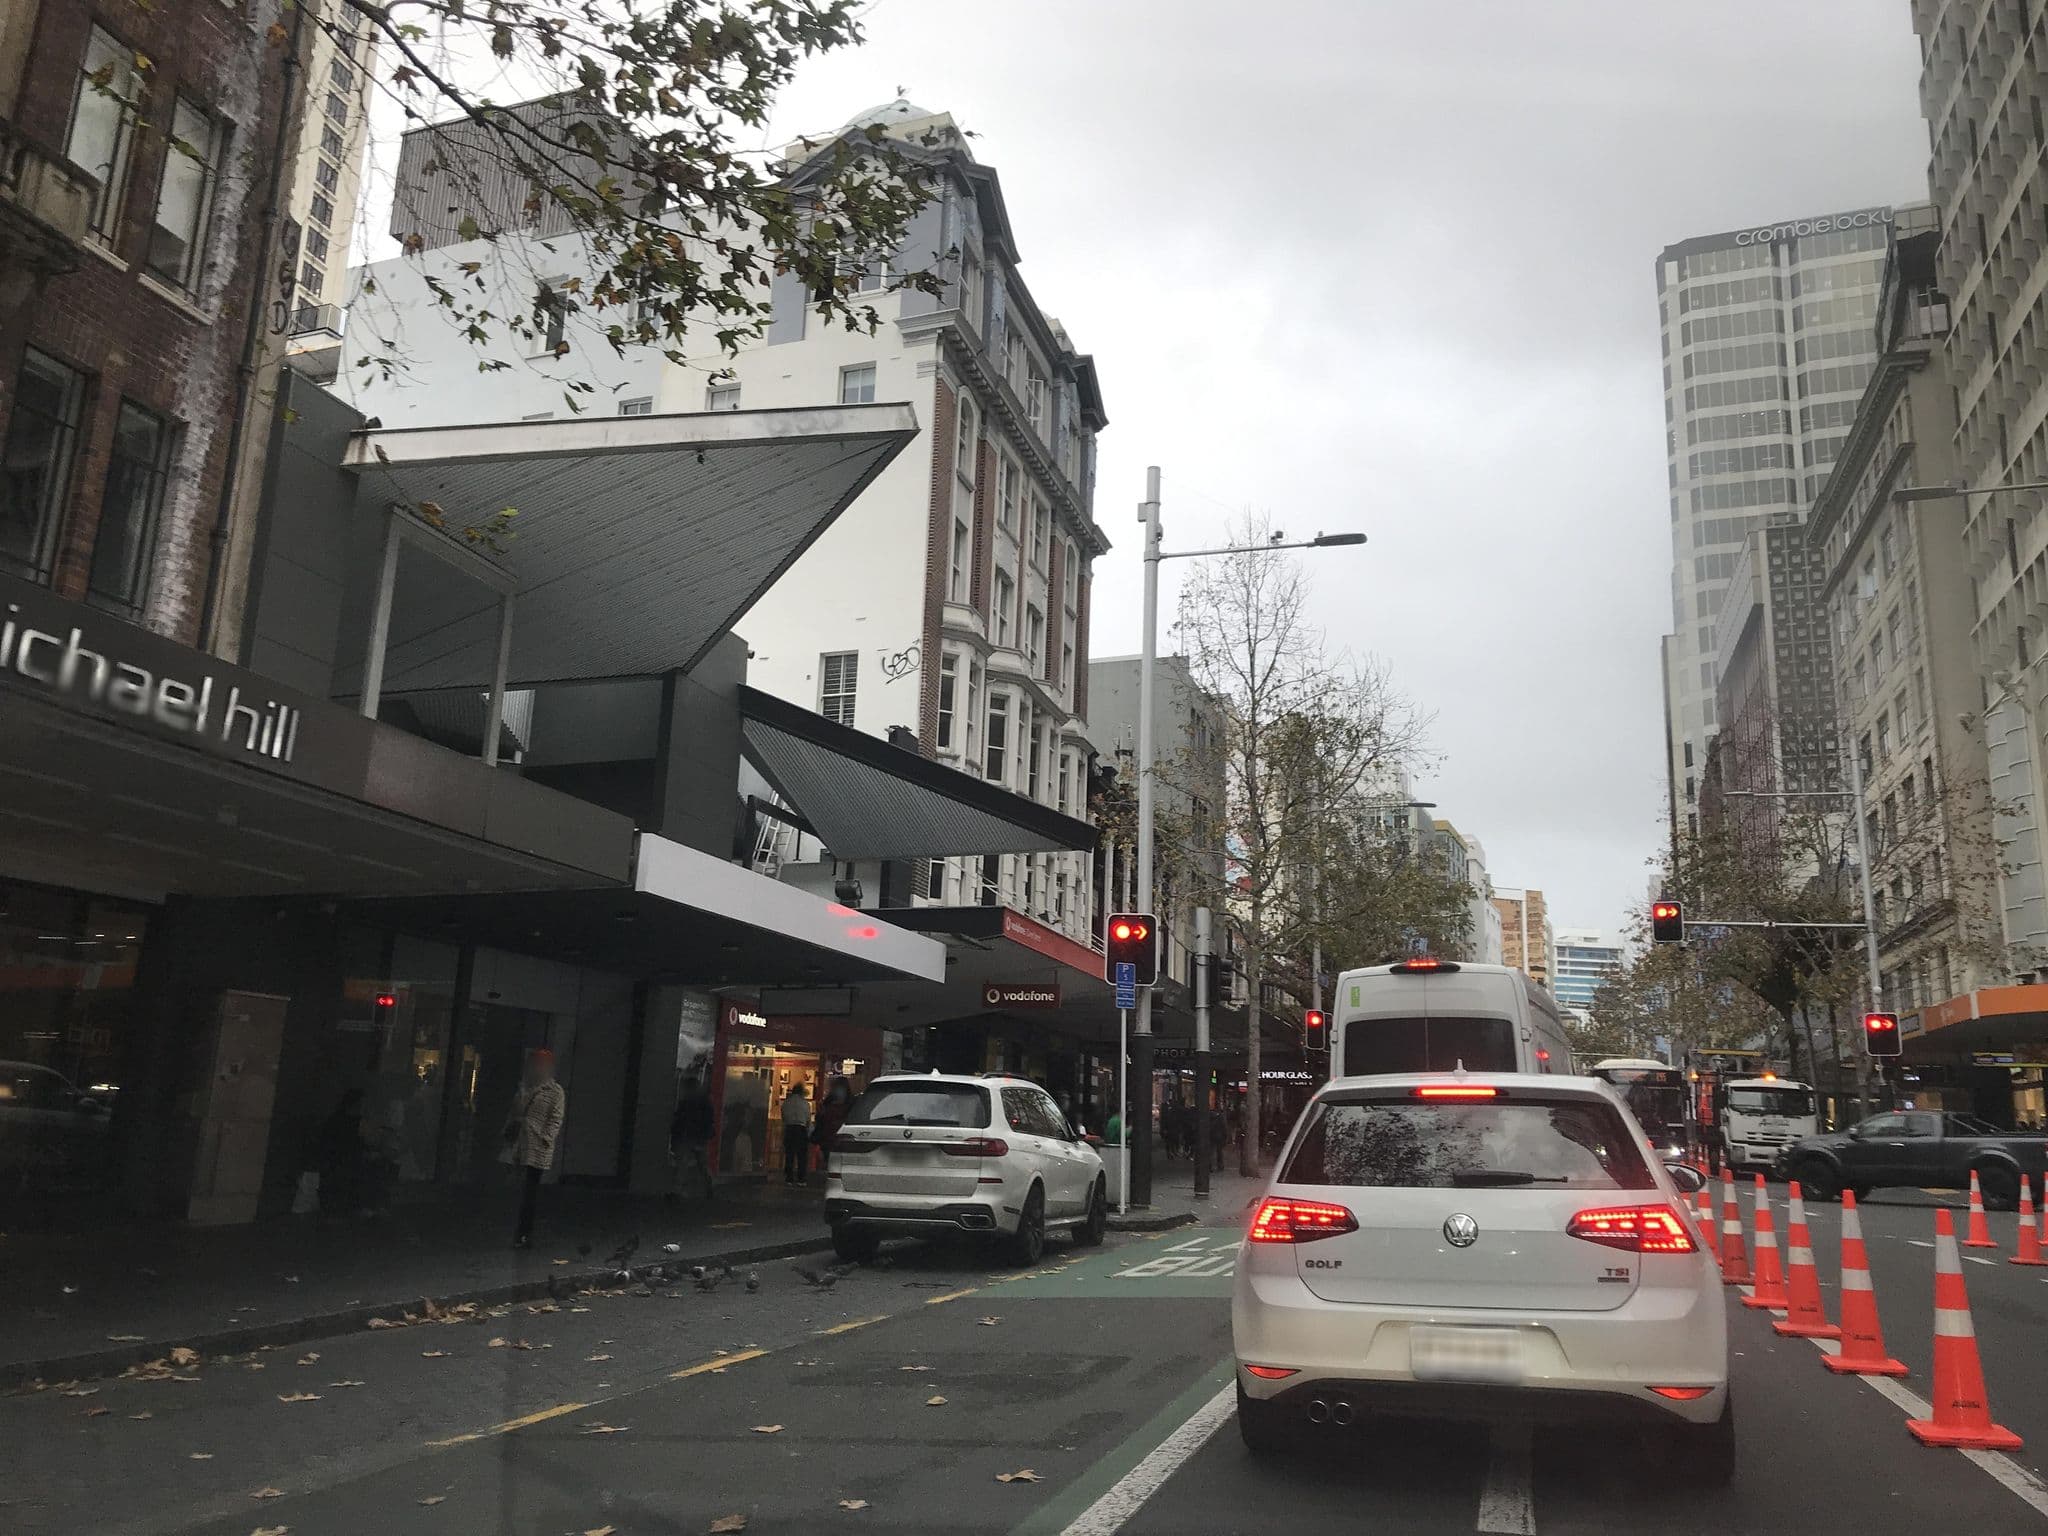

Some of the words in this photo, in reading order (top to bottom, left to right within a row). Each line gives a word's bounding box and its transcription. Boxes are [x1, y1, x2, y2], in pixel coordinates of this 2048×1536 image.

[222, 686, 299, 763] hill
[1003, 988, 1055, 1001] vodafone
[738, 1012, 767, 1028] vodafone
[1261, 1071, 1286, 1079] HOUR
[1111, 1256, 1236, 1278] BU
[1305, 1259, 1343, 1270] GOLF
[1604, 1267, 1629, 1277] TSI
